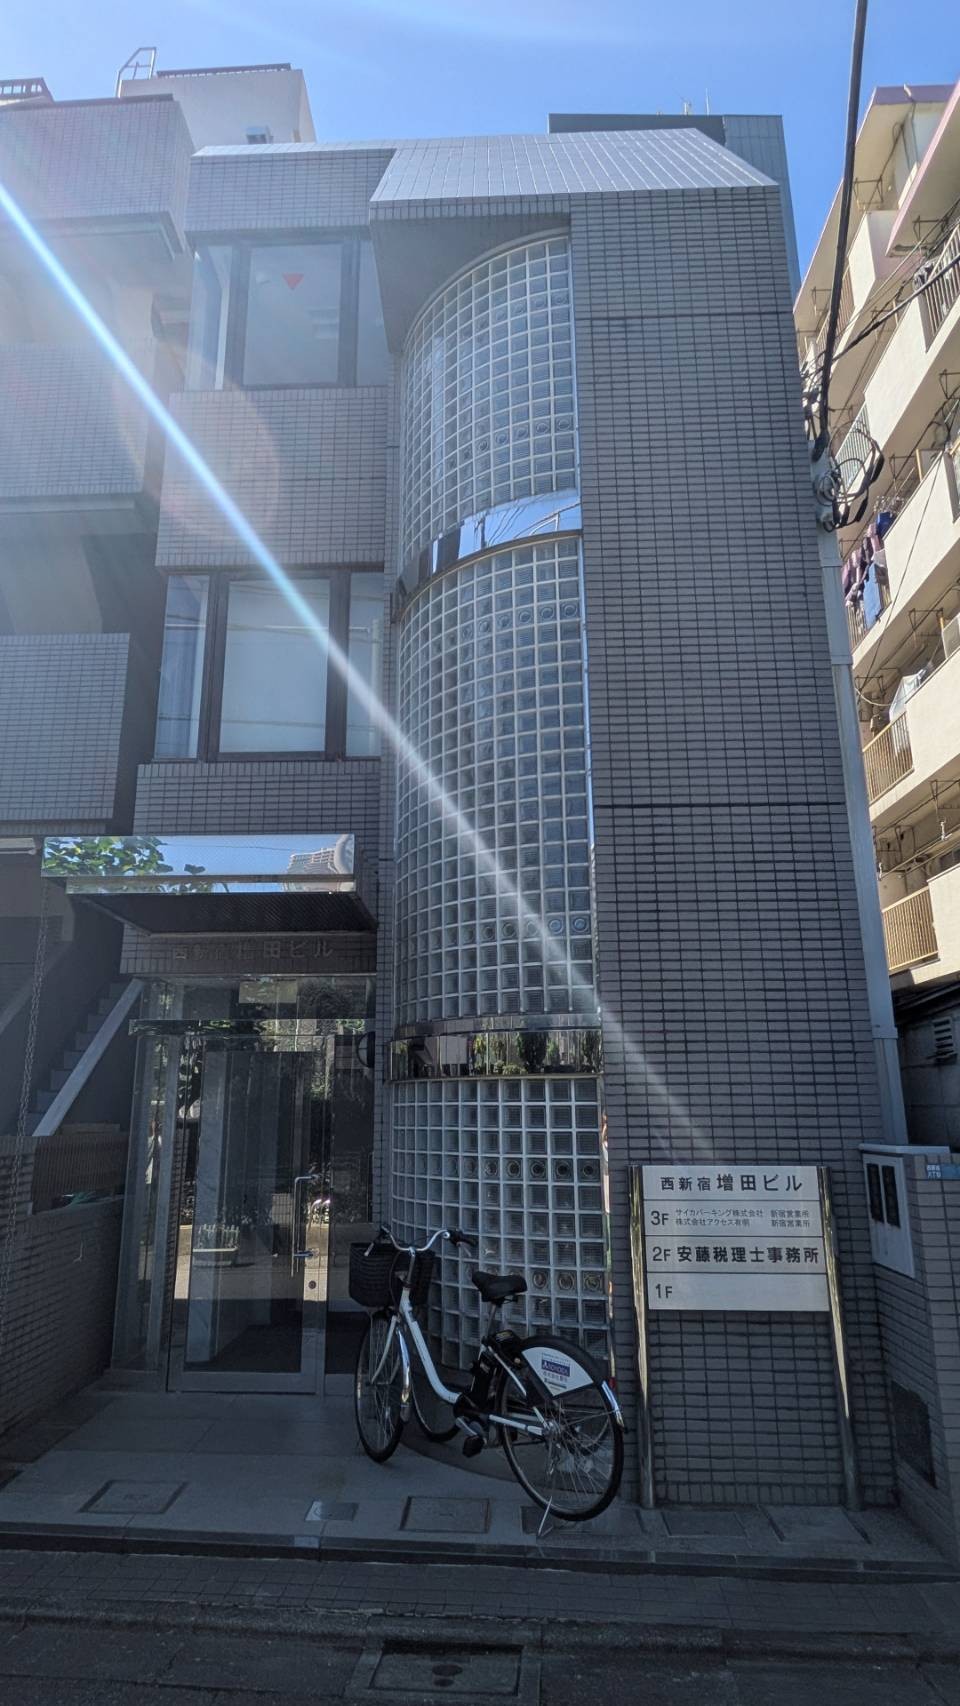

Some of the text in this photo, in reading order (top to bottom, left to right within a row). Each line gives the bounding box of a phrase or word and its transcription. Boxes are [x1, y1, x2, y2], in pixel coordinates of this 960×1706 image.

[660, 1173, 803, 1192] 西新宿増田ビル
[650, 1210, 669, 1226] 3F
[652, 1245, 820, 1264] 2F 安藤税理士事務所
[655, 1283, 673, 1299] 1F
